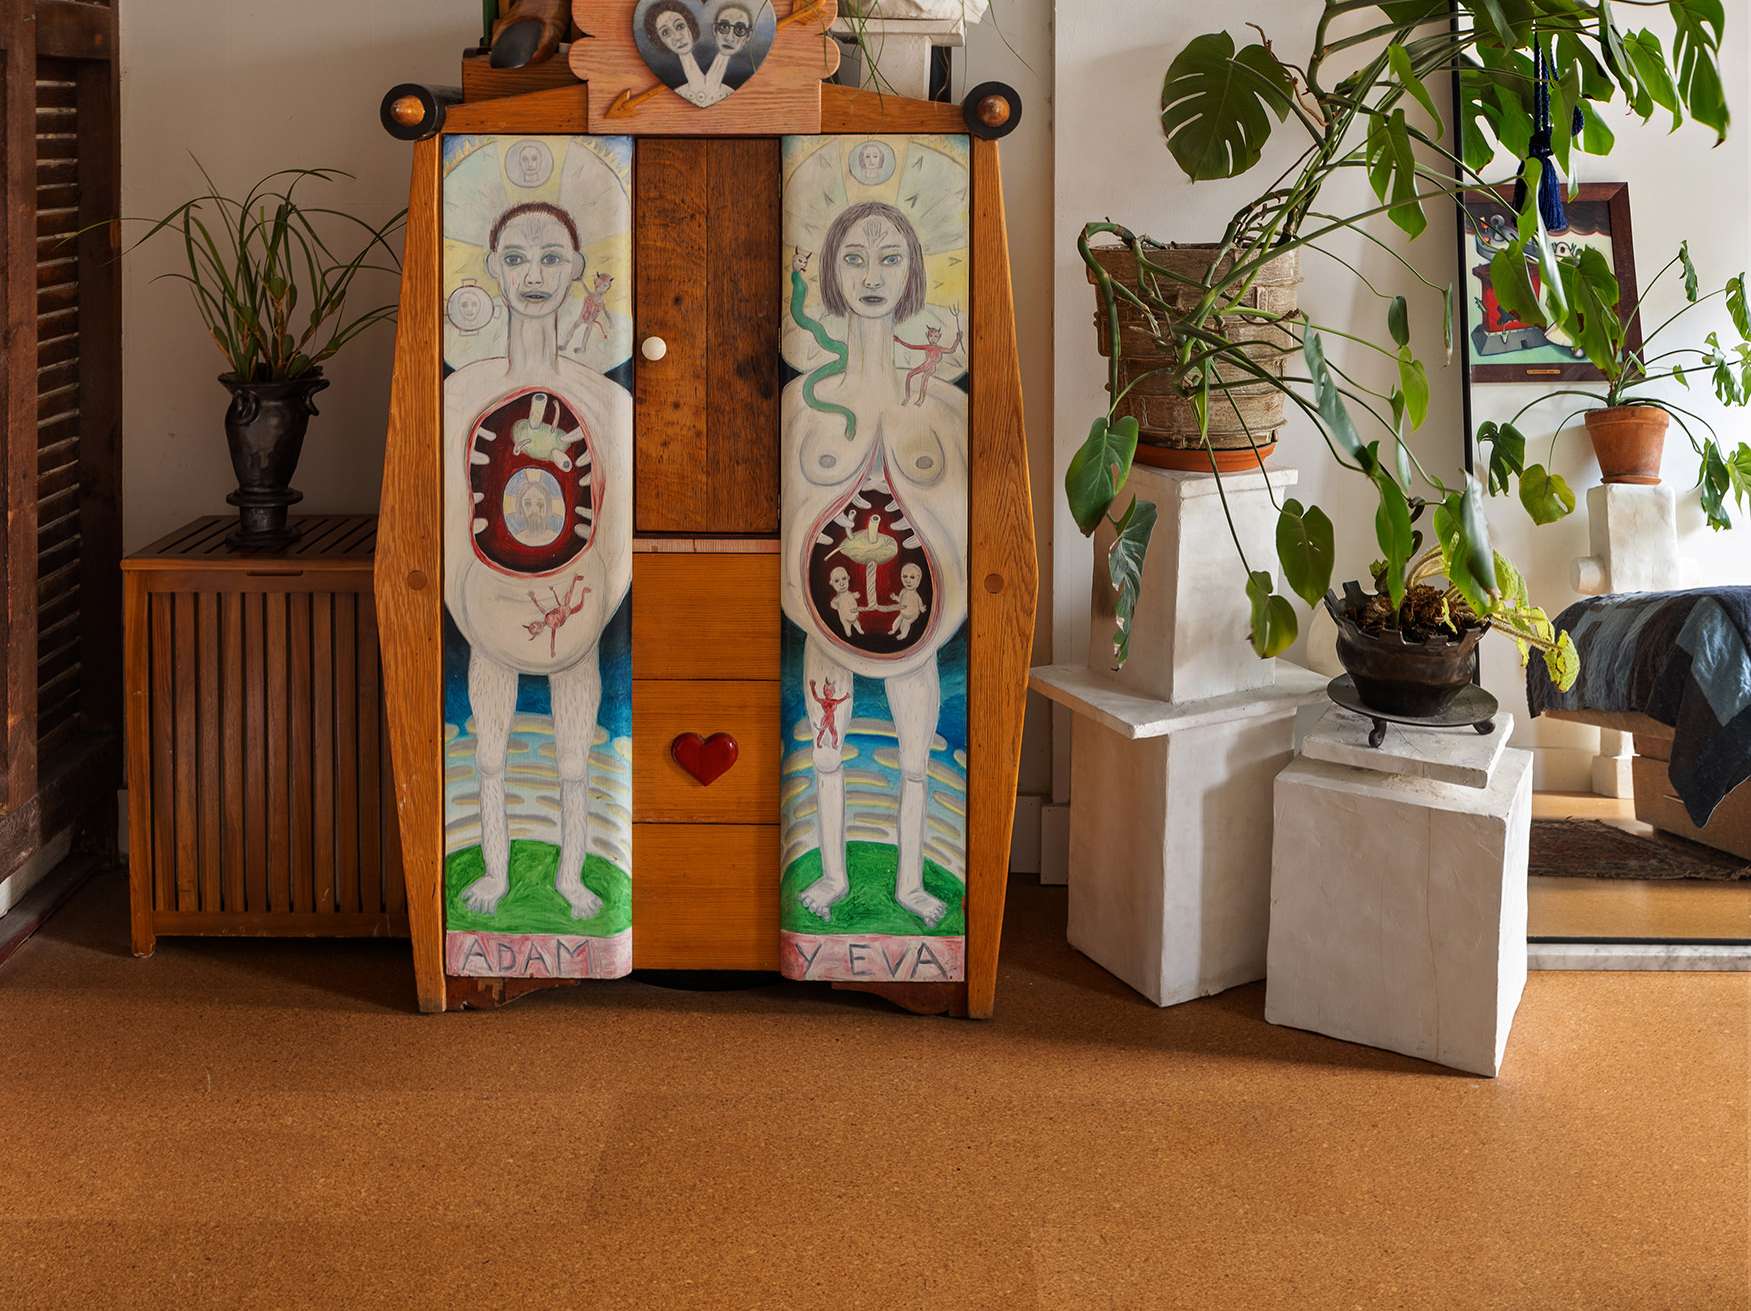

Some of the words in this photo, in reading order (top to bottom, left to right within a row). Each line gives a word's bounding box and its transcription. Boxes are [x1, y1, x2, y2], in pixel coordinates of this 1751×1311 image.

[461, 938, 593, 976] ADAM
[795, 942, 823, 978] Y
[849, 941, 949, 980] EVA
